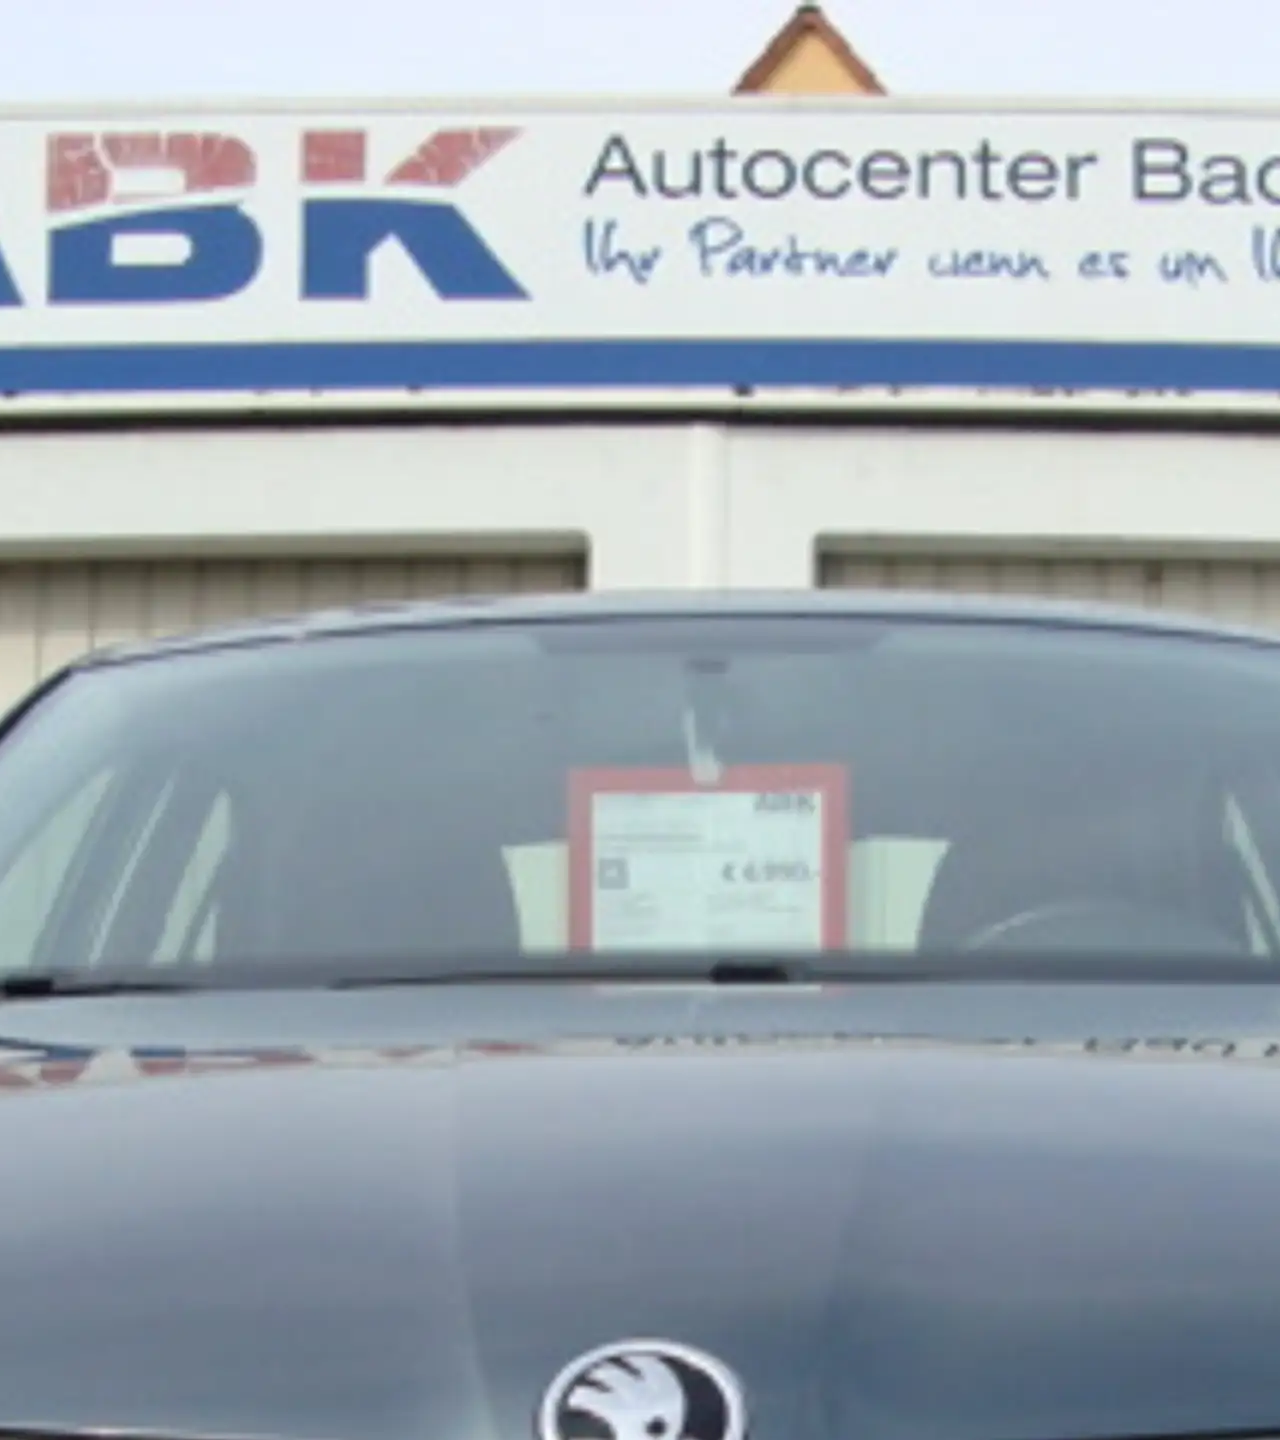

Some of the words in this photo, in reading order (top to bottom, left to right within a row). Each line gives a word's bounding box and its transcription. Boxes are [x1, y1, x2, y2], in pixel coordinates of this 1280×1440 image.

[583, 134, 1099, 200] Autocenter
[583, 216, 662, 285] Ihr
[689, 215, 899, 278] Partner
[1077, 249, 1132, 279] es
[1157, 251, 1229, 285] um
